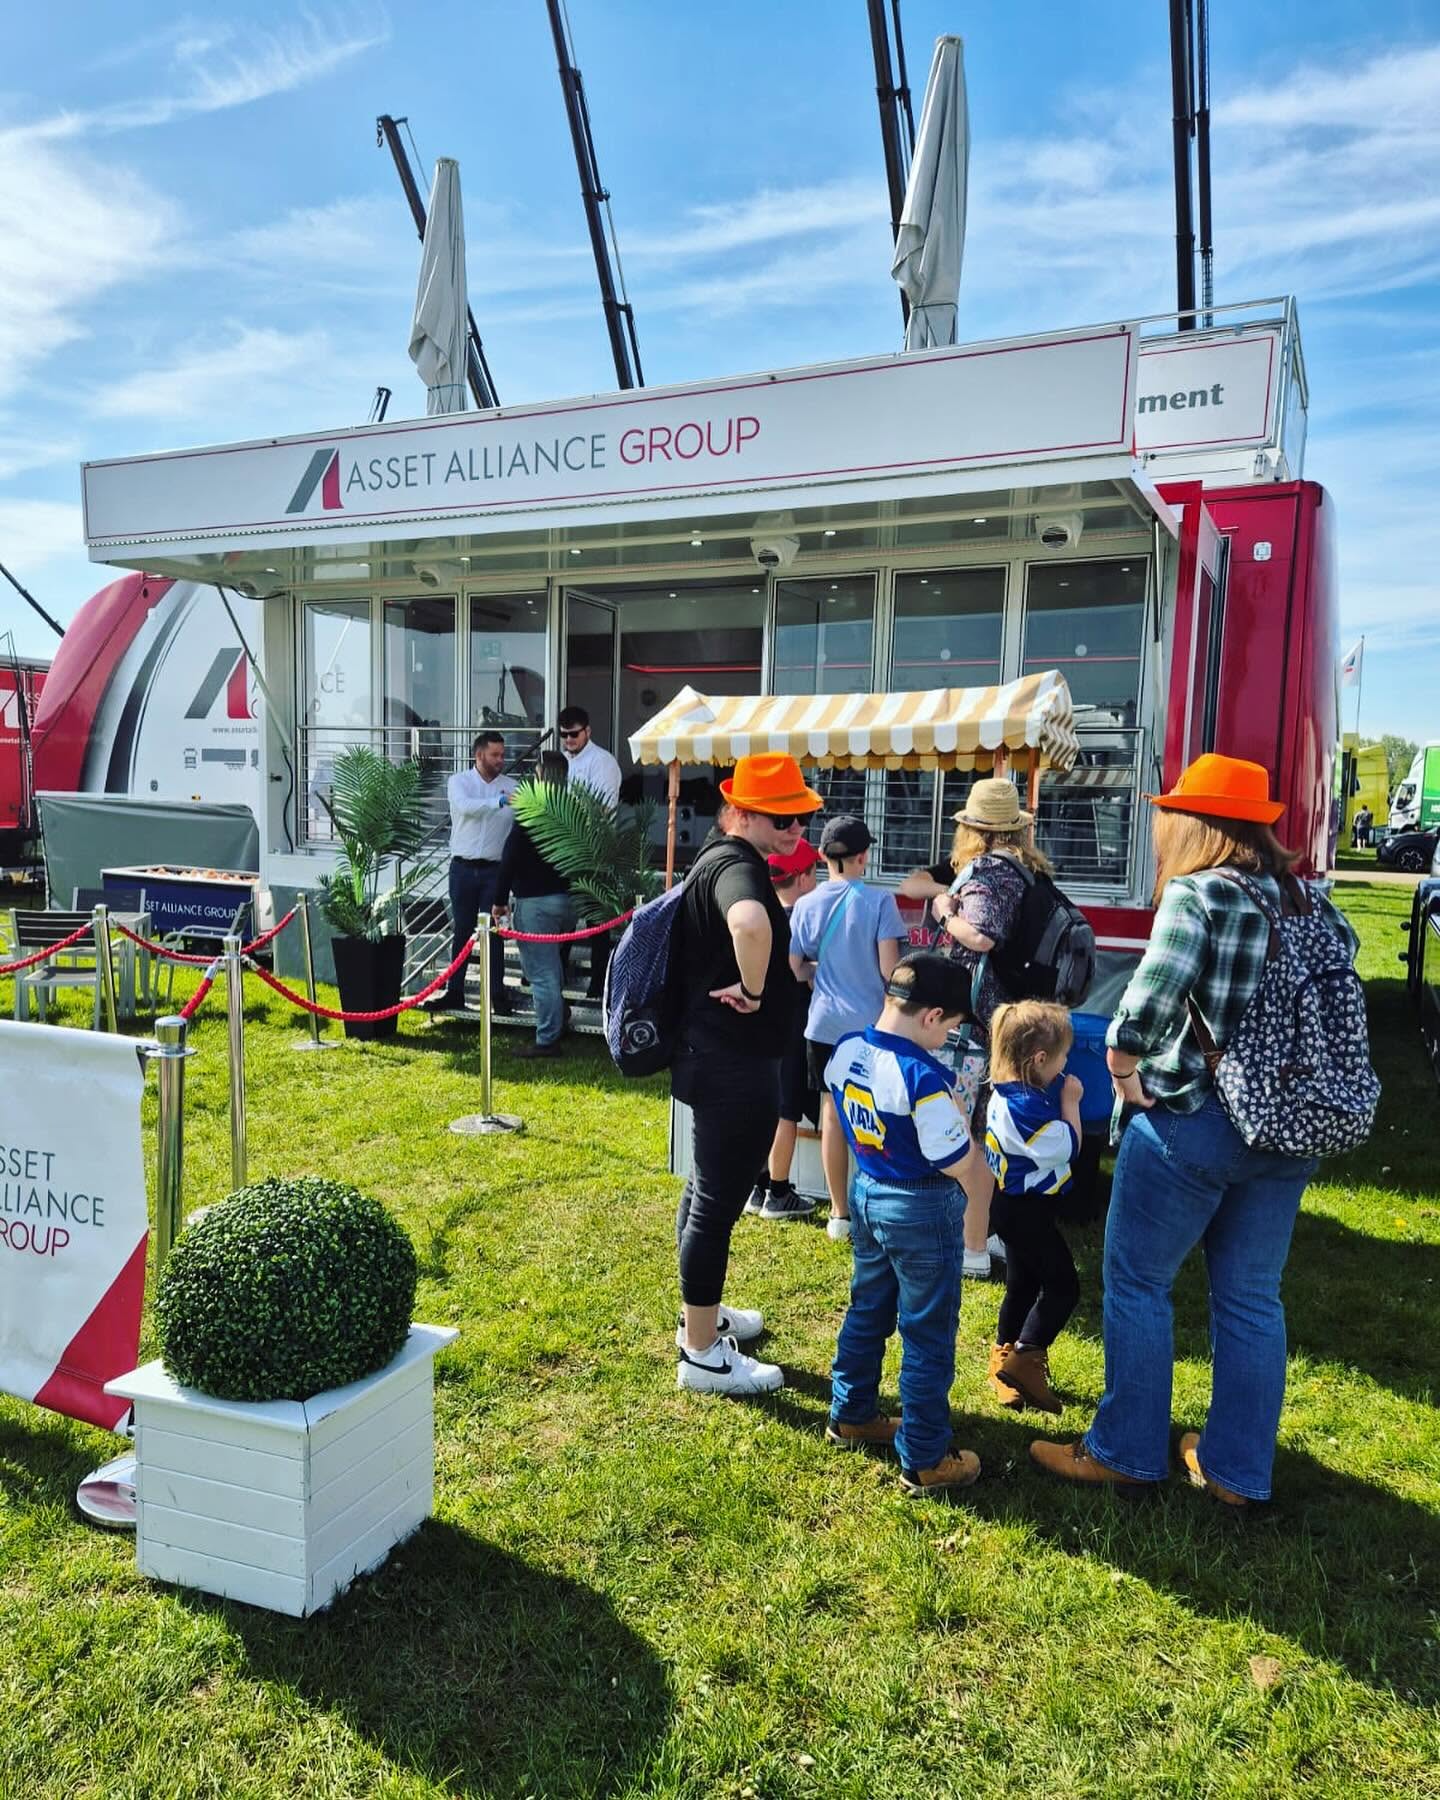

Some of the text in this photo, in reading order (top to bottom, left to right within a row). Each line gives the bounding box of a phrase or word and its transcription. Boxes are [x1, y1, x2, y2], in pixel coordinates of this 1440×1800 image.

[346, 416, 761, 493] ASSET ALLIANCE GROUP
[161, 902, 203, 916] ALLIANCE
[203, 906, 239, 919] GROUP
